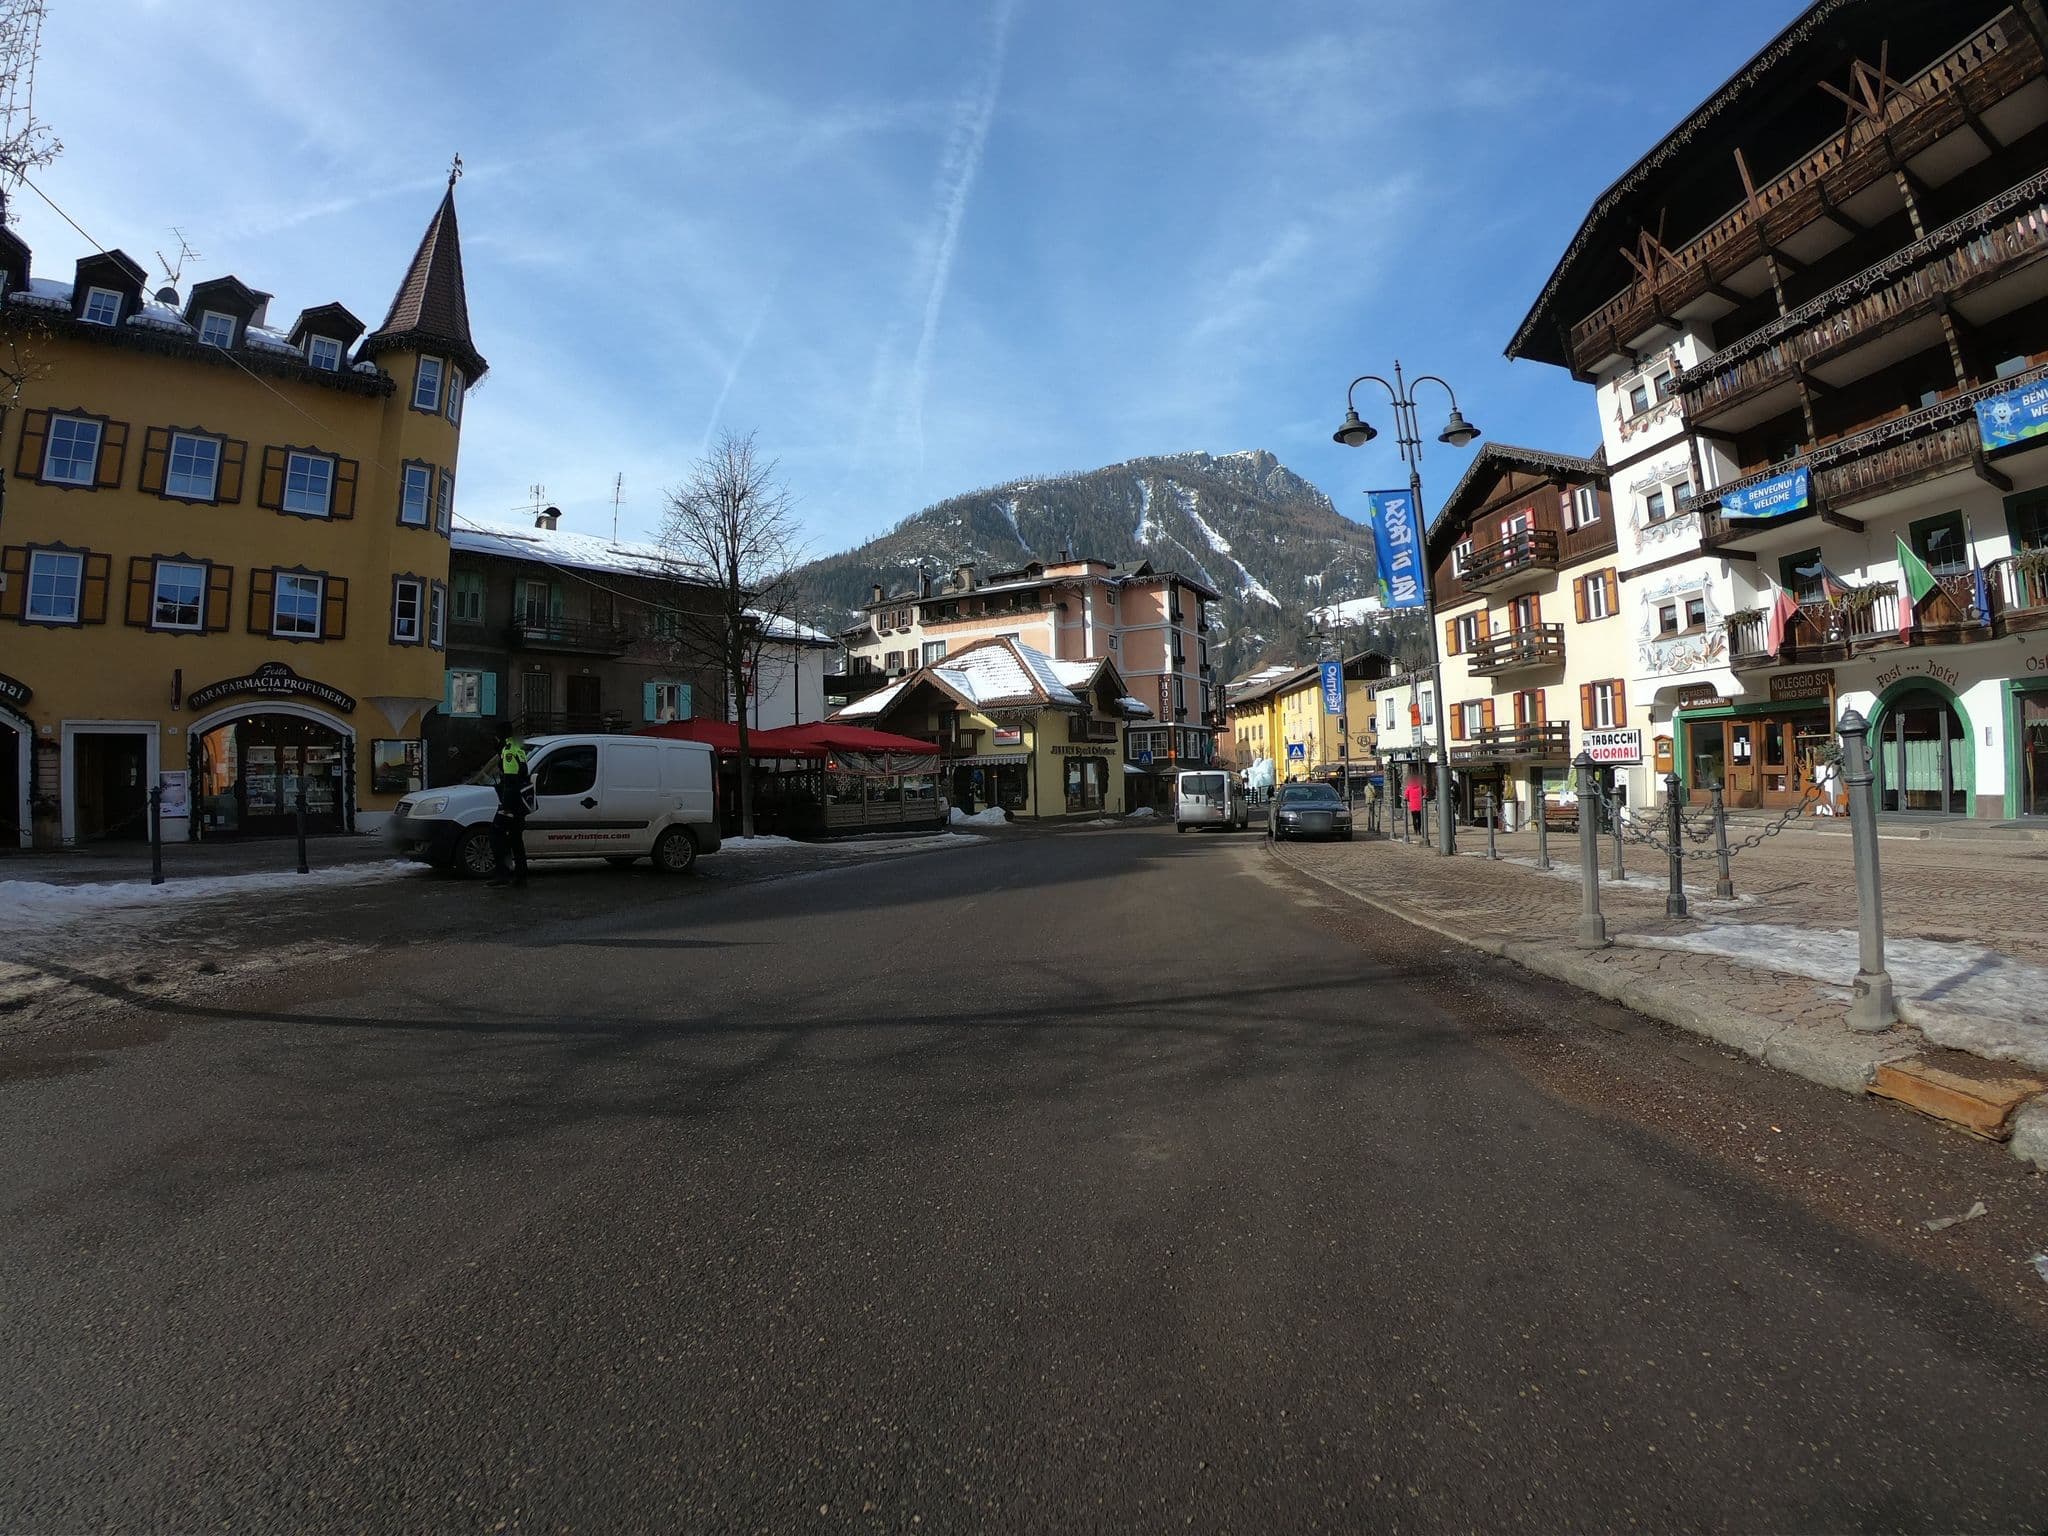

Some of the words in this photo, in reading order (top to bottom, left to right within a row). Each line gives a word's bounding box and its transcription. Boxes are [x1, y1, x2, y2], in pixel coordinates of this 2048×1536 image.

[1753, 491, 1790, 510] WELCOME
[263, 665, 288, 677] Festa
[1771, 674, 1813, 690] NOLEGGIO
[193, 677, 280, 706] PARAFARMACIA
[283, 678, 352, 711] PROFUMERIA
[1798, 686, 1821, 698] SPORT
[1161, 681, 1169, 721] HOTEL
[1591, 732, 1637, 746] TABACCHI
[1592, 747, 1638, 760] GIORNALI
